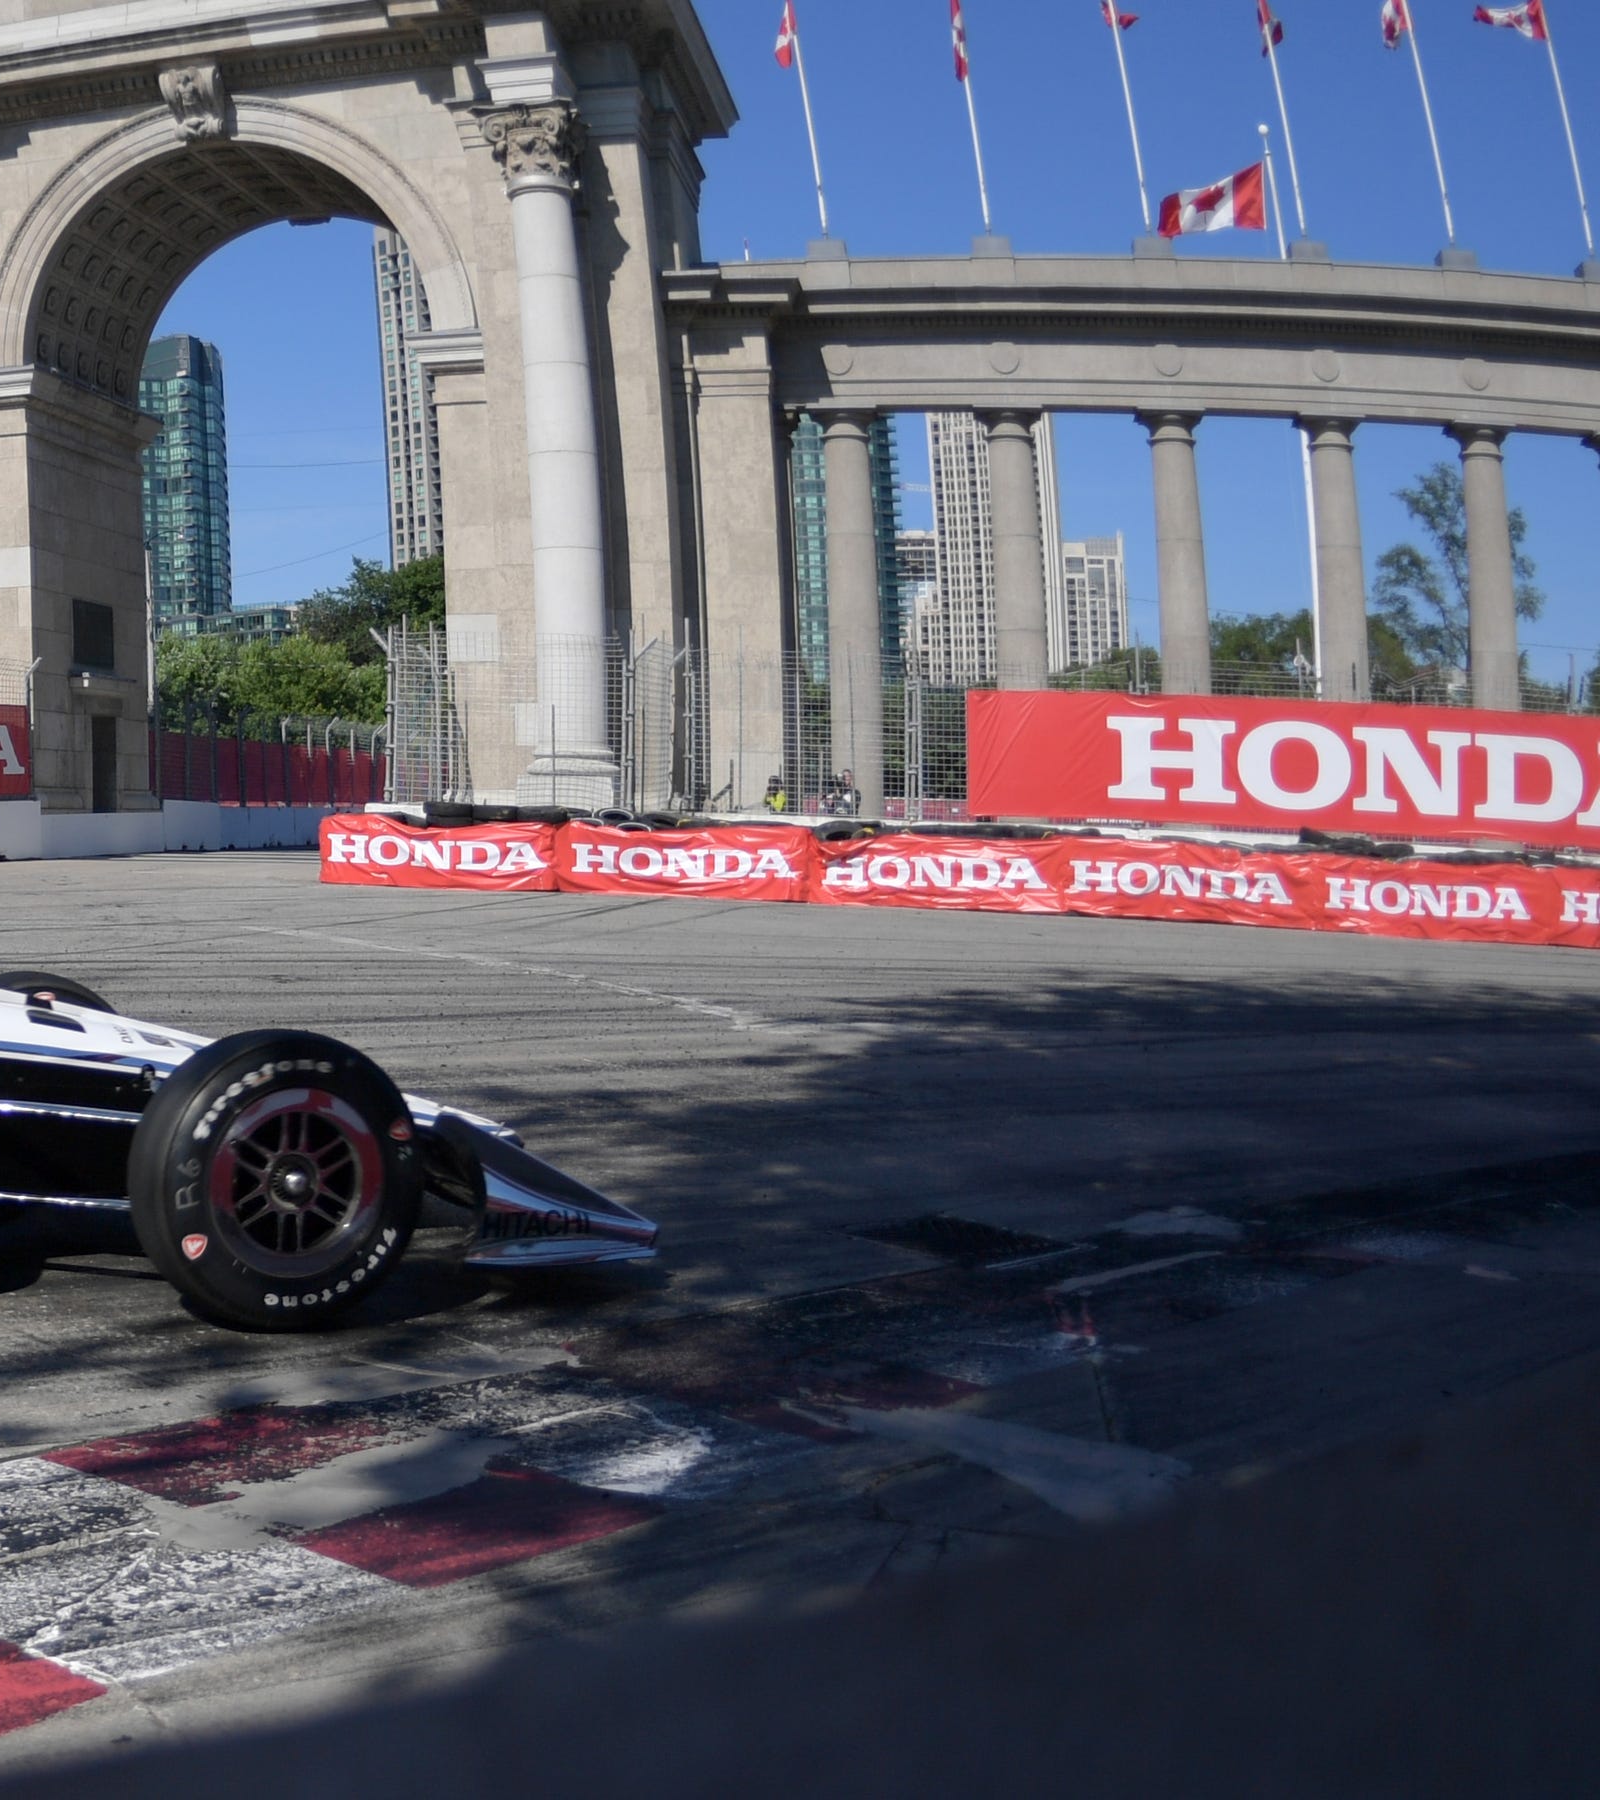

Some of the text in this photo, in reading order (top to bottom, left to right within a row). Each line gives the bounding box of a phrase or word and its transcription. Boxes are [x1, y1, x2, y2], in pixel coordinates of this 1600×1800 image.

[1107, 715, 1600, 827] HOND
[327, 833, 548, 872] HONDA
[571, 841, 798, 880] HONDA
[821, 854, 1048, 890] HONDA
[1064, 859, 1293, 906] HONDA
[1325, 877, 1531, 921] HONDA
[482, 1208, 592, 1240] HITACHI
[262, 1227, 398, 1308] Firestone
